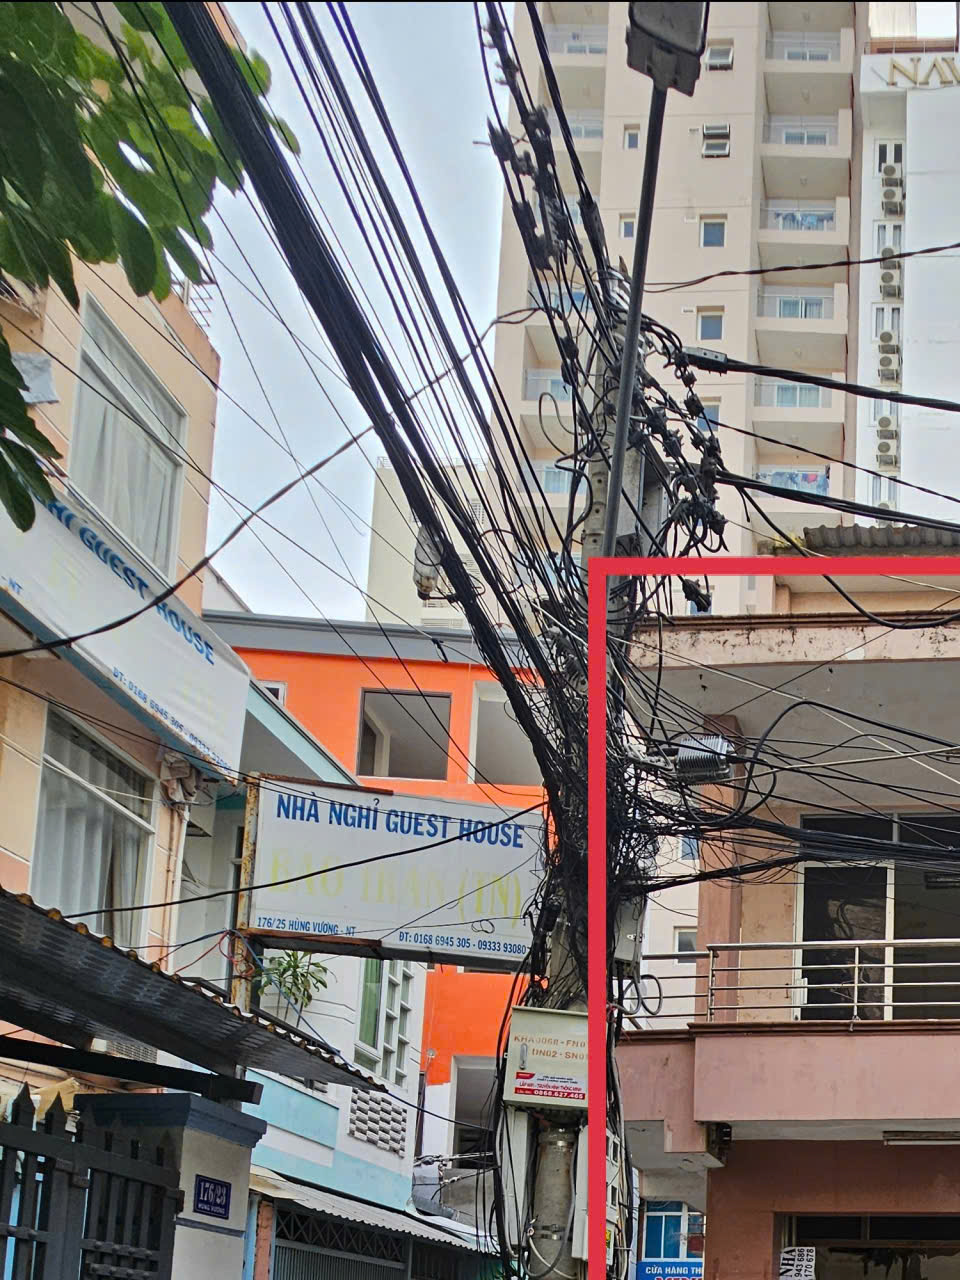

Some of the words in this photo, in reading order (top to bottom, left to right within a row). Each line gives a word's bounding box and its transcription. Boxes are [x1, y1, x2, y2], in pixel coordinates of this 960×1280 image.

[79, 525, 149, 600] GUEST
[156, 601, 215, 666] HOUSE
[277, 791, 320, 823] NHÀ
[328, 798, 380, 831] NGHỈ
[385, 809, 452, 839] GUEST
[458, 818, 524, 849] HOUSE
[288, 917, 310, 932] HÙNG
[312, 921, 339, 935] VƯƠNG
[399, 931, 412, 943] ĐT:
[413, 933, 433, 945] 0168
[435, 935, 454, 947] 6945
[456, 938, 471, 949] 305
[477, 939, 501, 952] 09333
